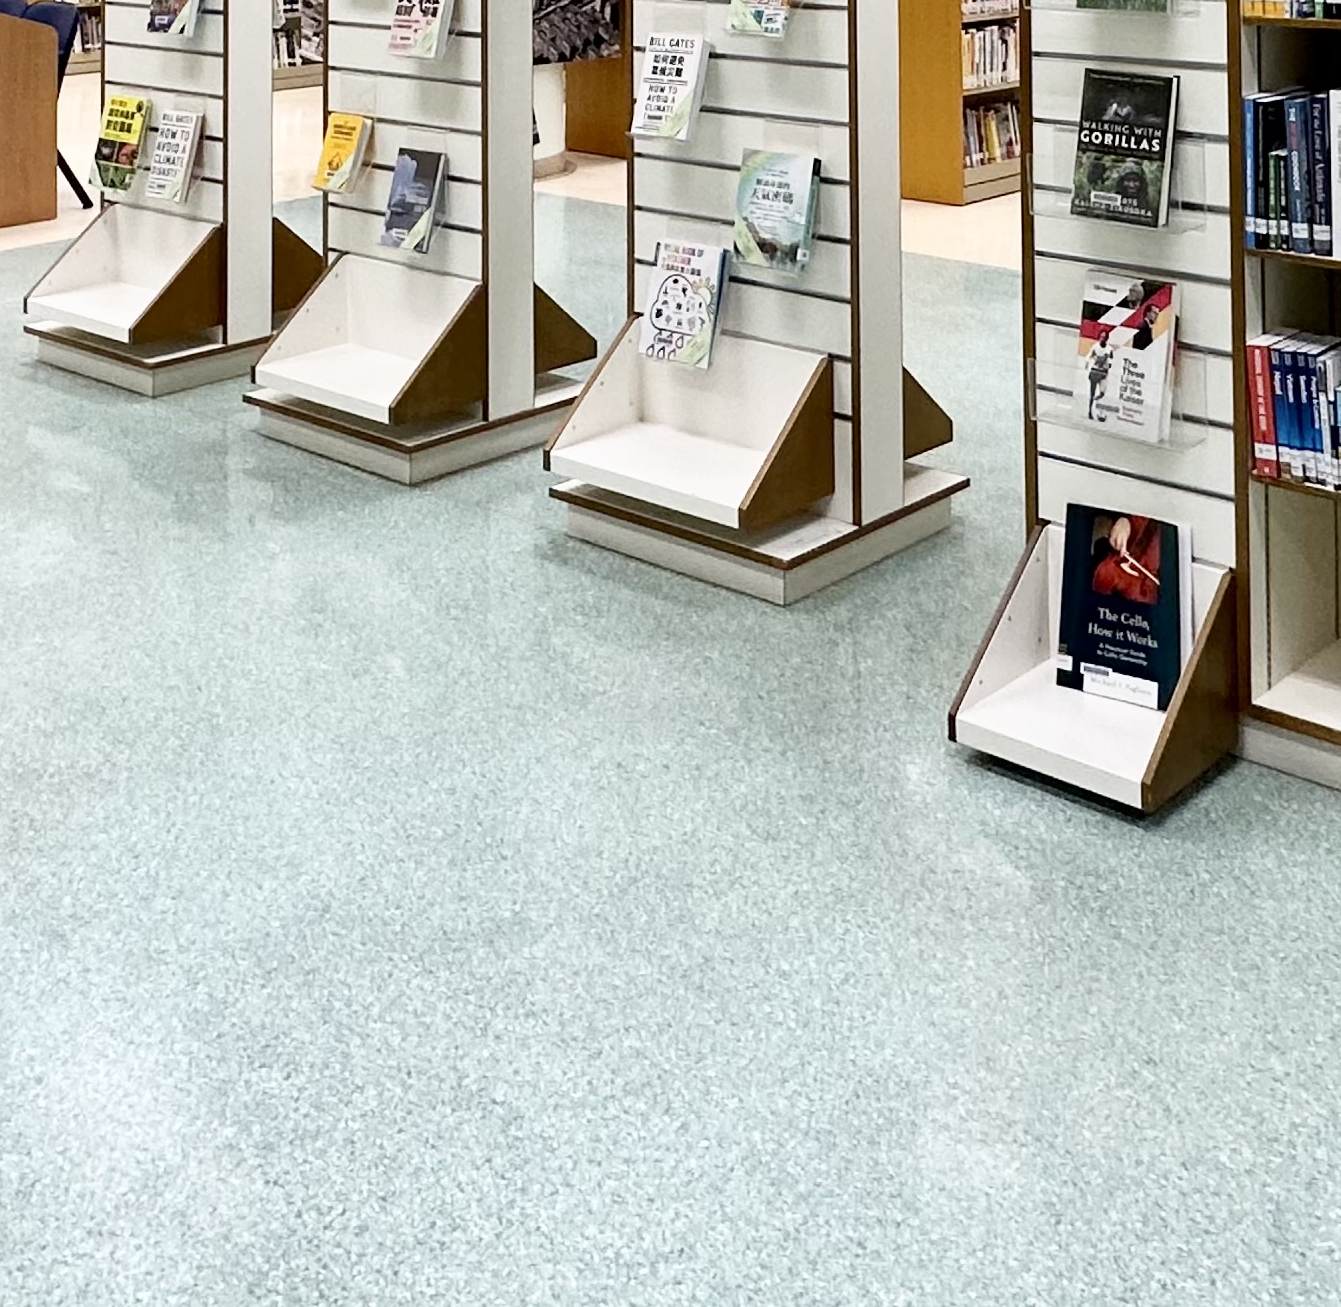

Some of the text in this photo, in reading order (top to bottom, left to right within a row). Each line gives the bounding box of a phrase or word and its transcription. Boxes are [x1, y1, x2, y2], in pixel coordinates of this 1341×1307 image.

[649, 36, 696, 49] BILL GATES
[648, 83, 678, 94] HOW TO
[1081, 119, 1162, 138] WALKING WITH
[1080, 130, 1161, 152] GORILLAS
[1122, 357, 1138, 369] The
[1122, 366, 1146, 379] Three
[1097, 606, 1151, 632] The Cello,
[1087, 621, 1159, 649] How it Works
